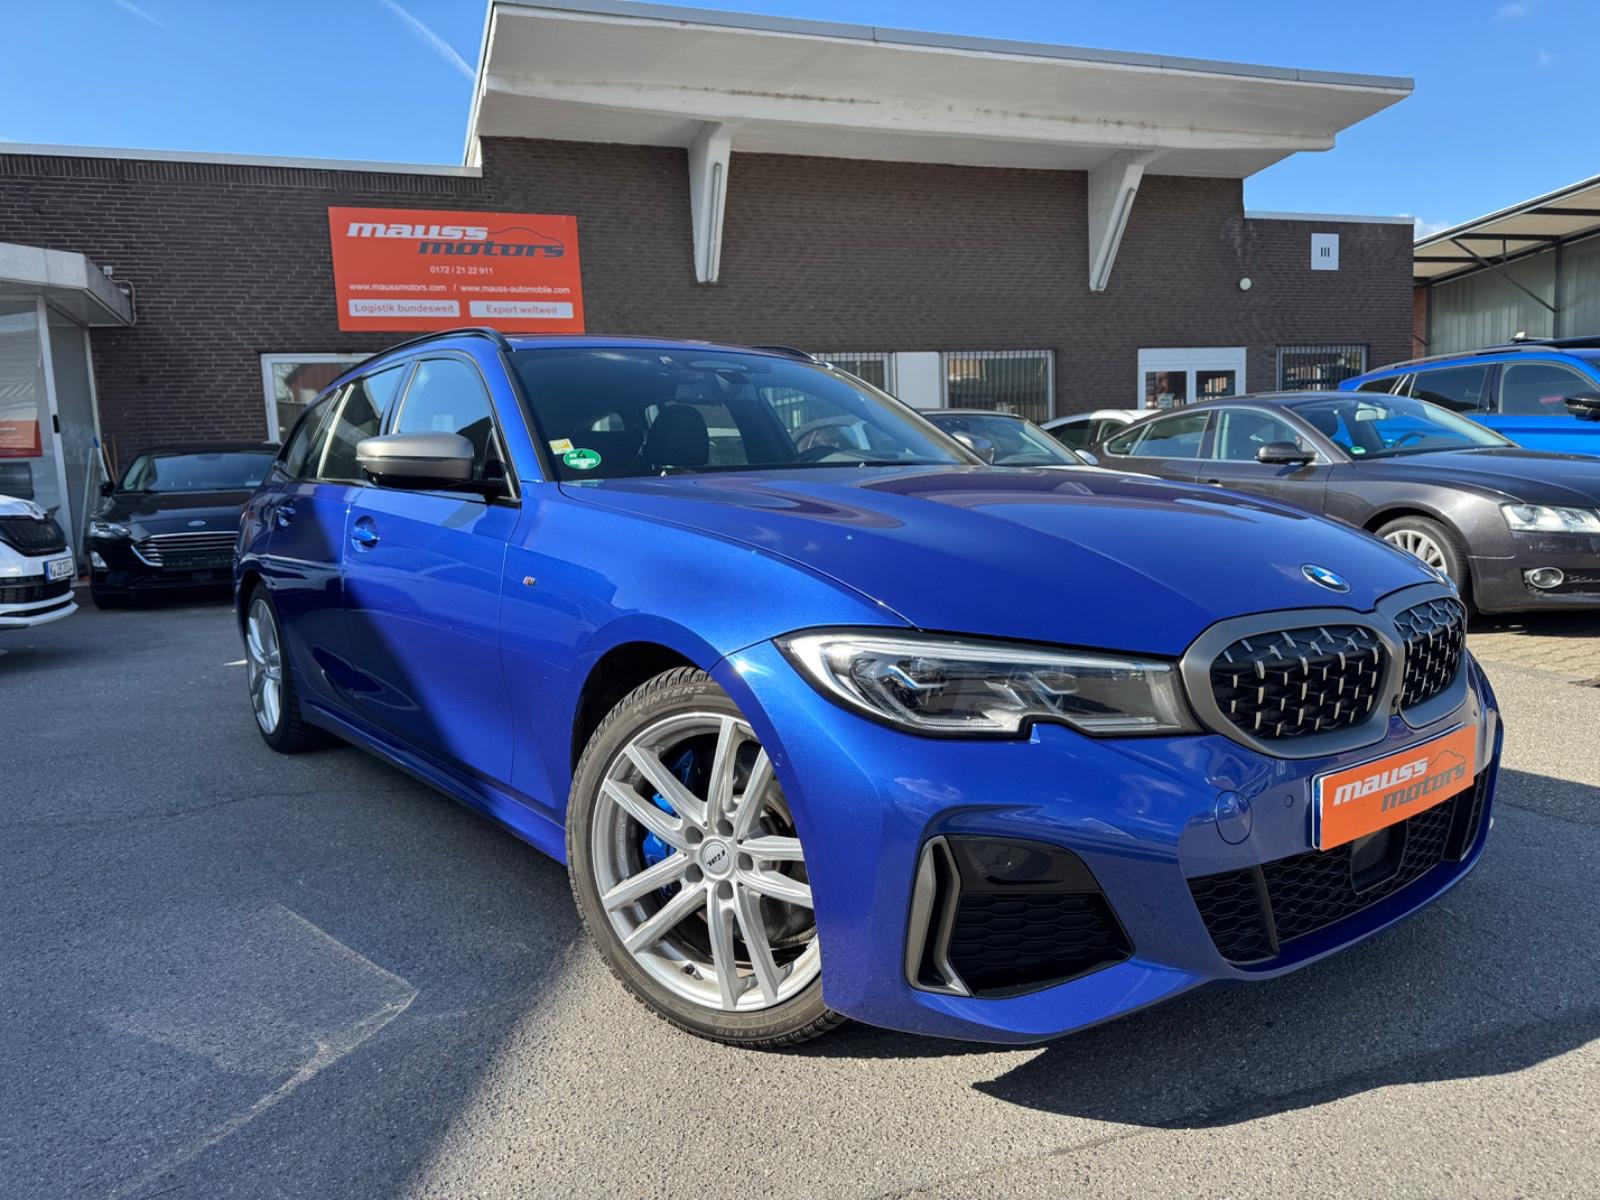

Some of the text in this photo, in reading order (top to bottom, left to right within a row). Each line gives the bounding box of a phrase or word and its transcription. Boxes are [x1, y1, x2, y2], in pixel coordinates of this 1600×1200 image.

[346, 223, 488, 240] mauss
[418, 241, 565, 257] motors
[430, 265, 449, 274] 0172
[456, 266, 466, 274] 21
[467, 266, 478, 275] 22
[479, 267, 494, 275] 911
[349, 283, 447, 292] www.maussmotors.com
[460, 285, 571, 295] www.mauss-automobile.com
[354, 303, 454, 314] Logistik bundesweit
[486, 305, 558, 315] Export weltweit
[1333, 757, 1429, 806] mauss
[1381, 764, 1467, 812] motors
